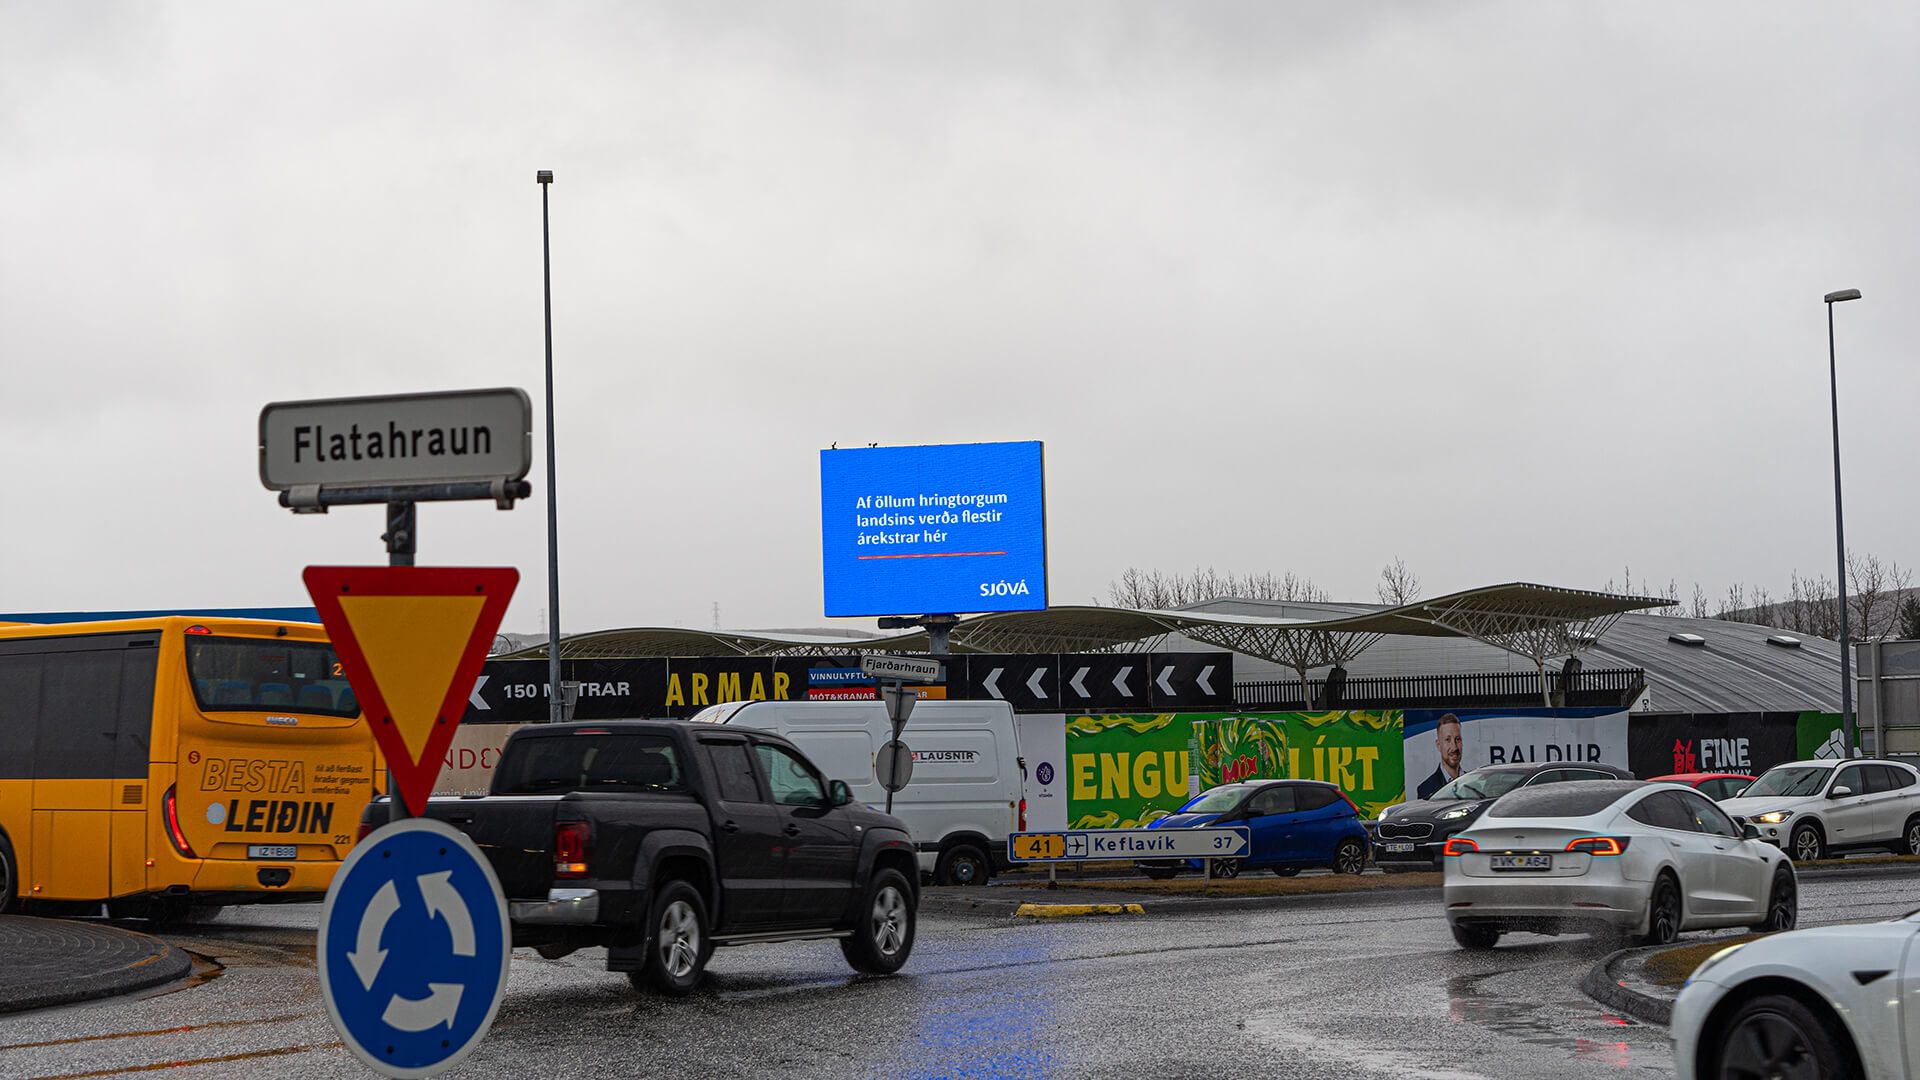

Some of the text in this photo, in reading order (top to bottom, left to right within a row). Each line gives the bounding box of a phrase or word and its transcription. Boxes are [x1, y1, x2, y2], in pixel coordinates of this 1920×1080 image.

[293, 421, 492, 463] Flatahraun
[856, 493, 1008, 509] Af öllum hringtorgum
[856, 509, 1003, 527] landsins verða flestir
[857, 529, 948, 545] árekstrar hér
[979, 579, 1030, 597] SJÓVÁ
[865, 659, 936, 675] Fjarðarhraun
[503, 681, 631, 699] 150 MTRAR
[665, 671, 791, 707] ARMAR
[920, 752, 974, 760] LAUSNIR
[1700, 737, 1751, 769] FINE
[200, 758, 306, 793] BESTA
[1071, 750, 1190, 801] ENGU
[225, 799, 335, 834] LEIÐIN
[334, 835, 351, 845] 221
[1029, 840, 1050, 853] 41
[1094, 836, 1233, 851] Keflavík 37
